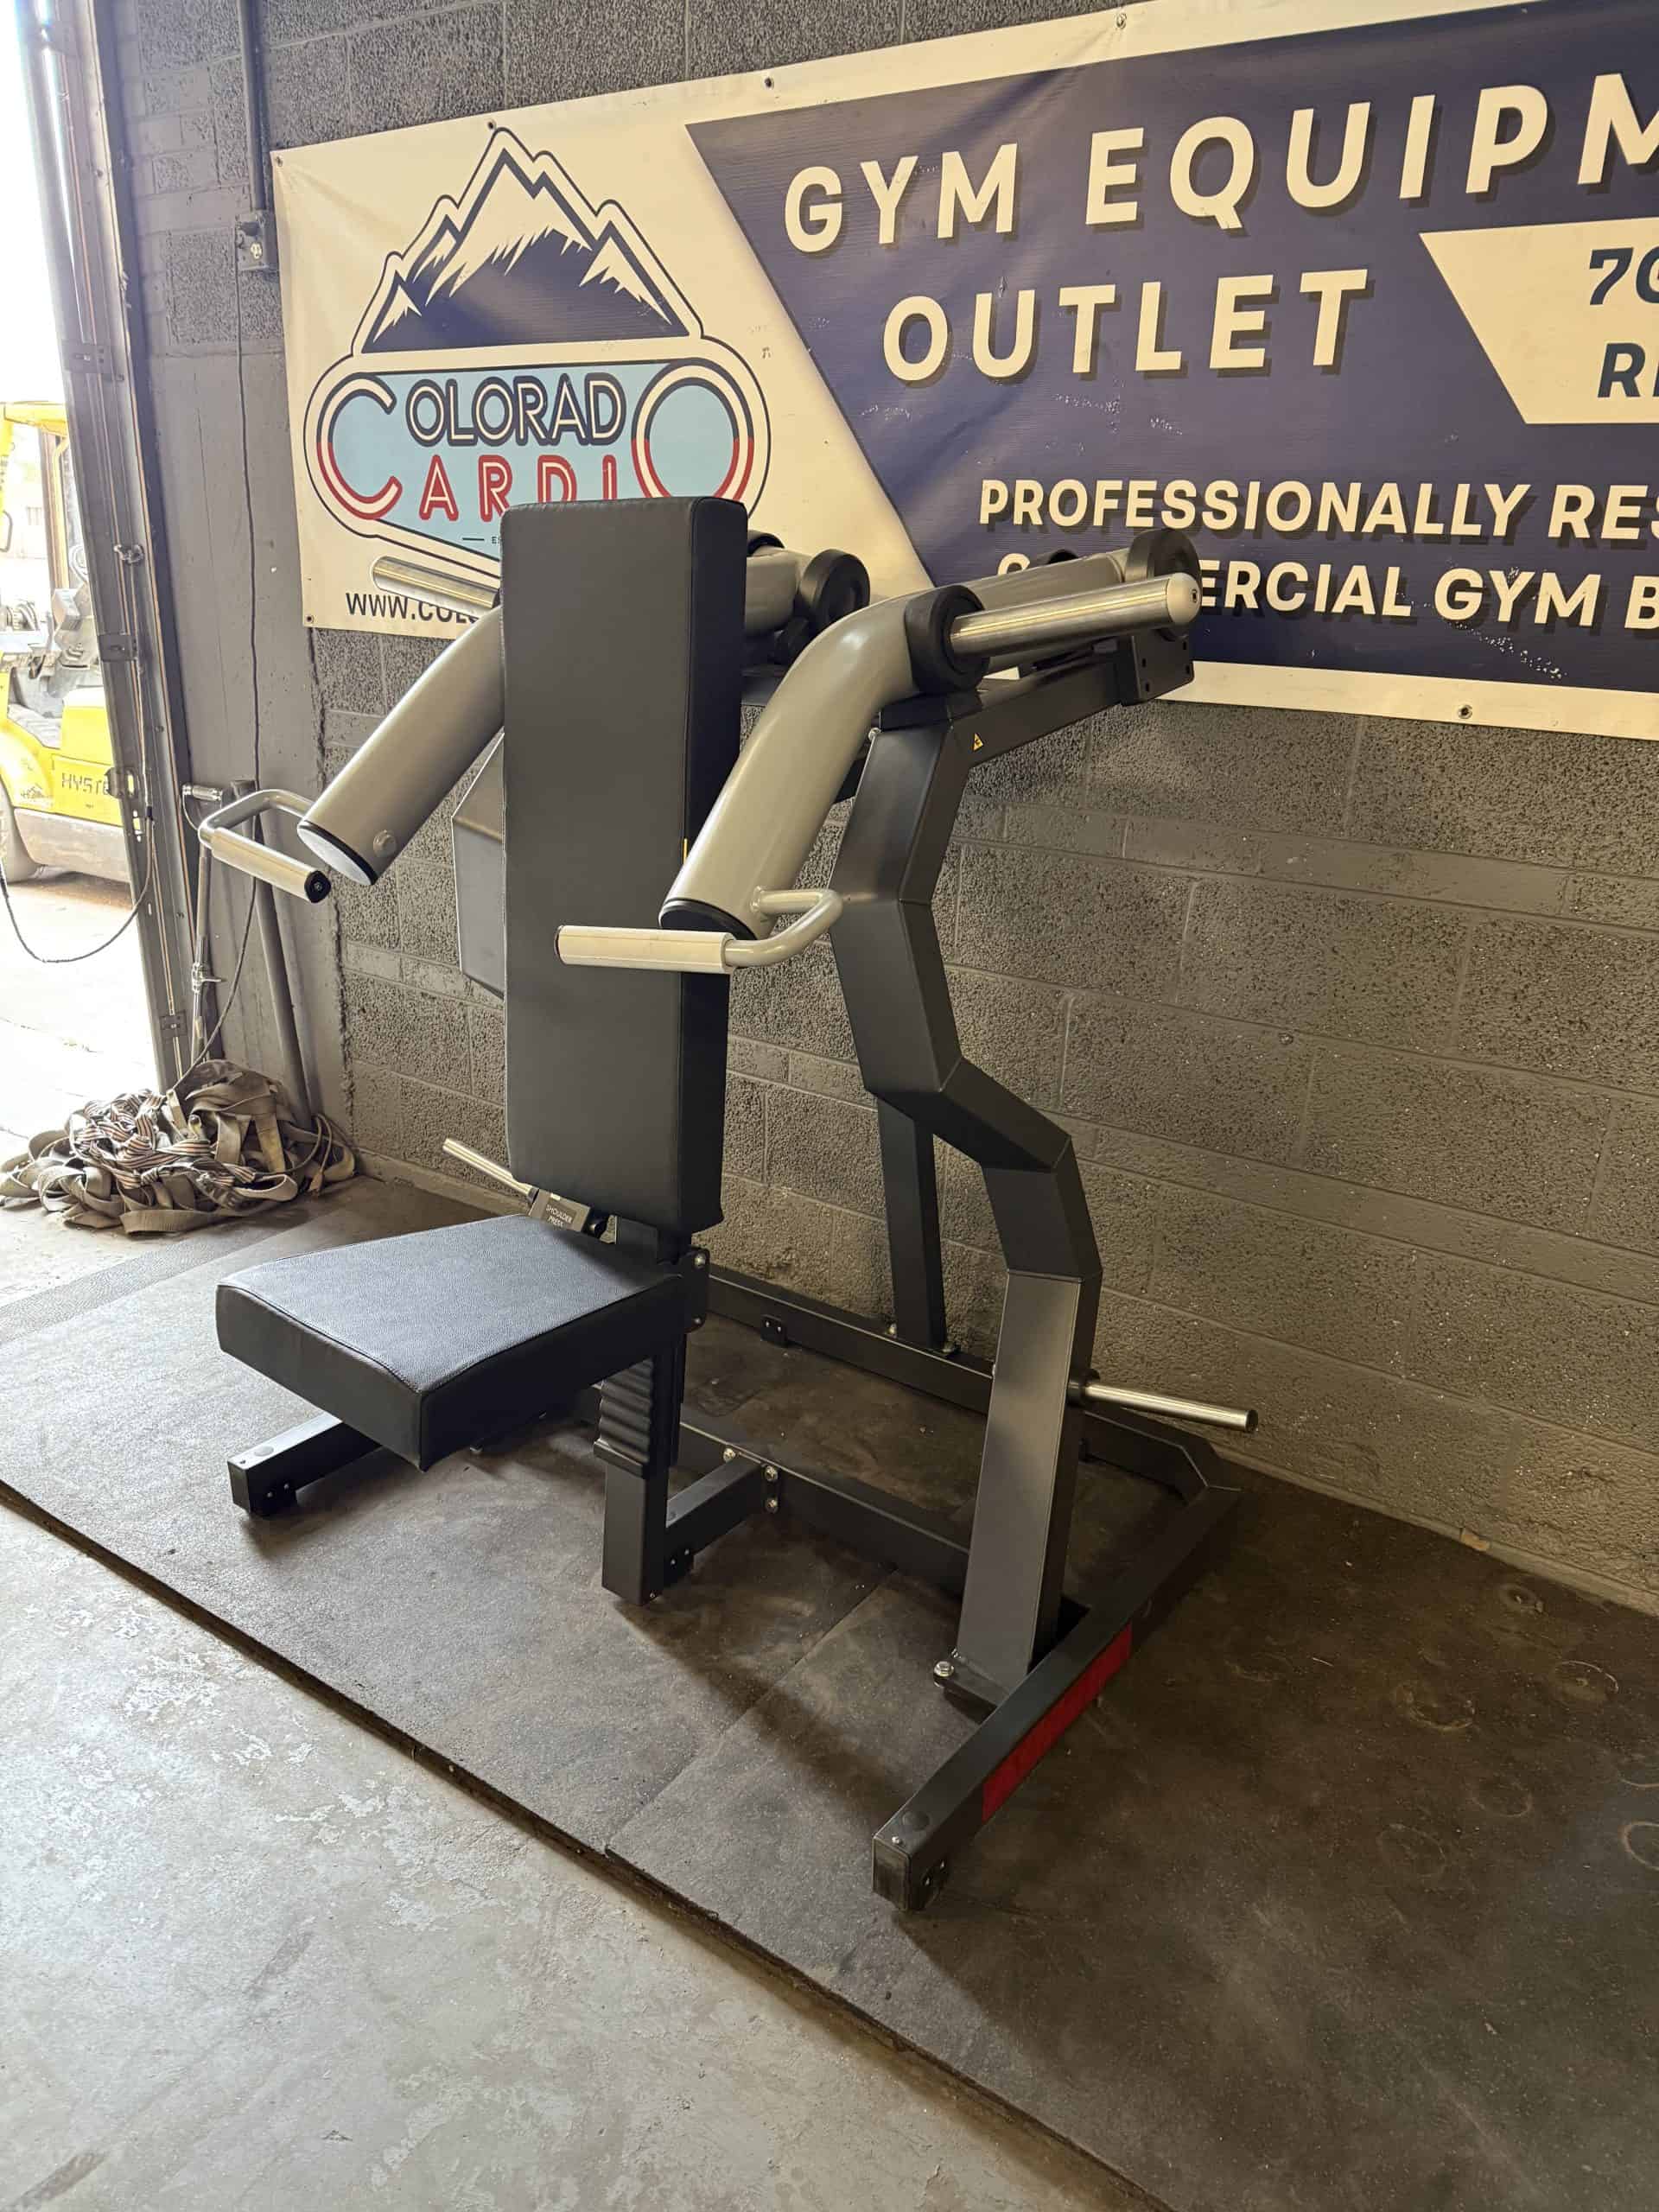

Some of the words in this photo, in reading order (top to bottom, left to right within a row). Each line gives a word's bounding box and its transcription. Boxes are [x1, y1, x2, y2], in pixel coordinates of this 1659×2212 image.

[784, 143, 1018, 253] GYM
[883, 269, 1369, 382] OUTLET
[1597, 342, 1659, 398] R
[979, 478, 1532, 537] PROFESSIONALLY
[1548, 485, 1659, 540] RE
[1433, 567, 1602, 627] GYM
